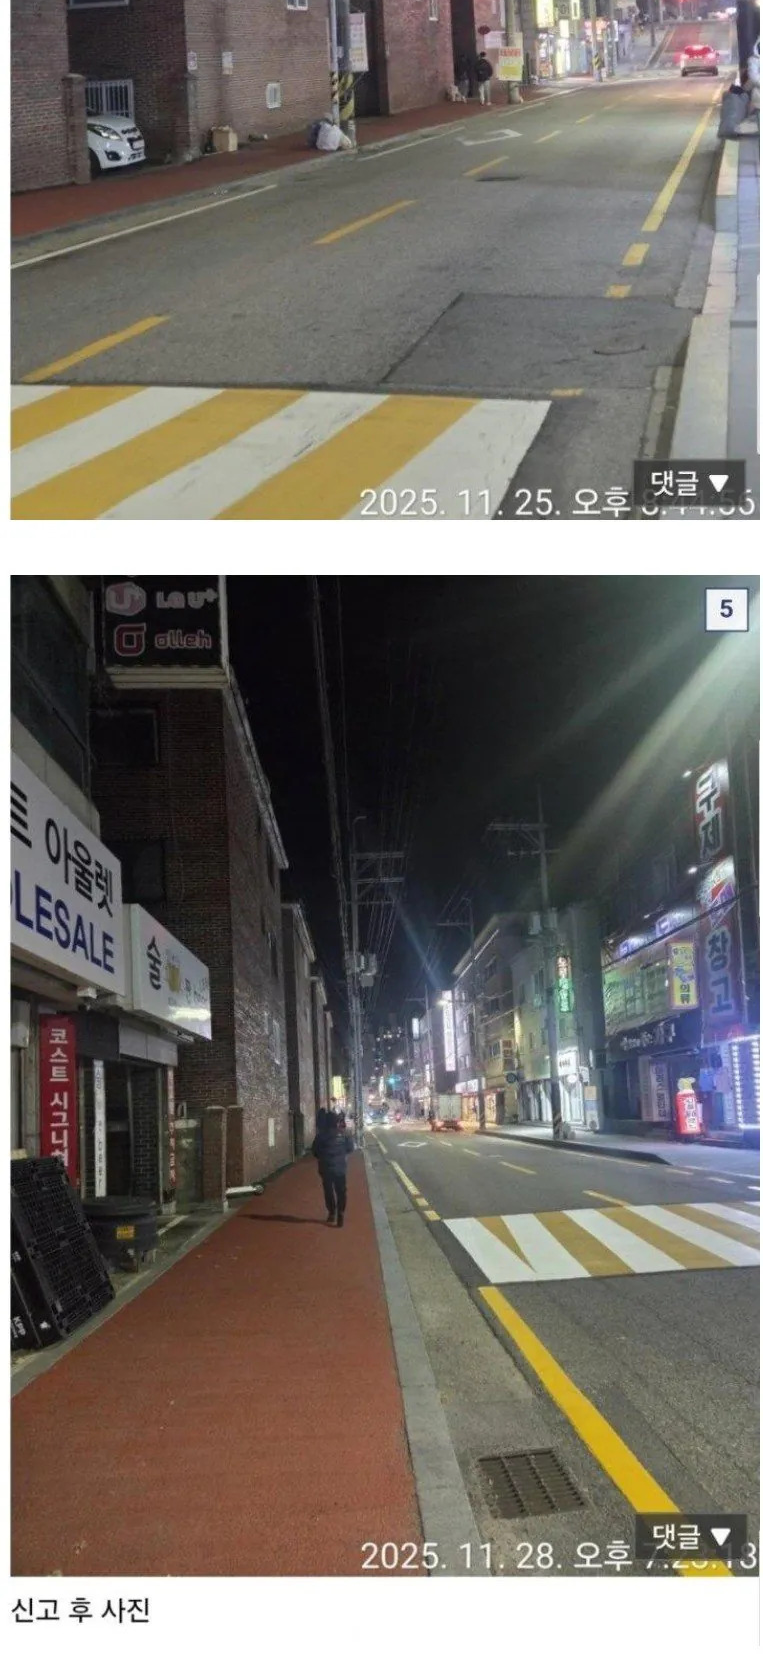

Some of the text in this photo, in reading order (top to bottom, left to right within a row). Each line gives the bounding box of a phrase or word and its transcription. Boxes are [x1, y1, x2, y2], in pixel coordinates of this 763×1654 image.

[154, 628, 213, 650] olleh
[44, 817, 114, 919] 아울렛
[10, 869, 116, 976] LESALE
[146, 934, 163, 992] 술
[706, 928, 734, 1016] 창고
[49, 1027, 70, 1083] 코스트
